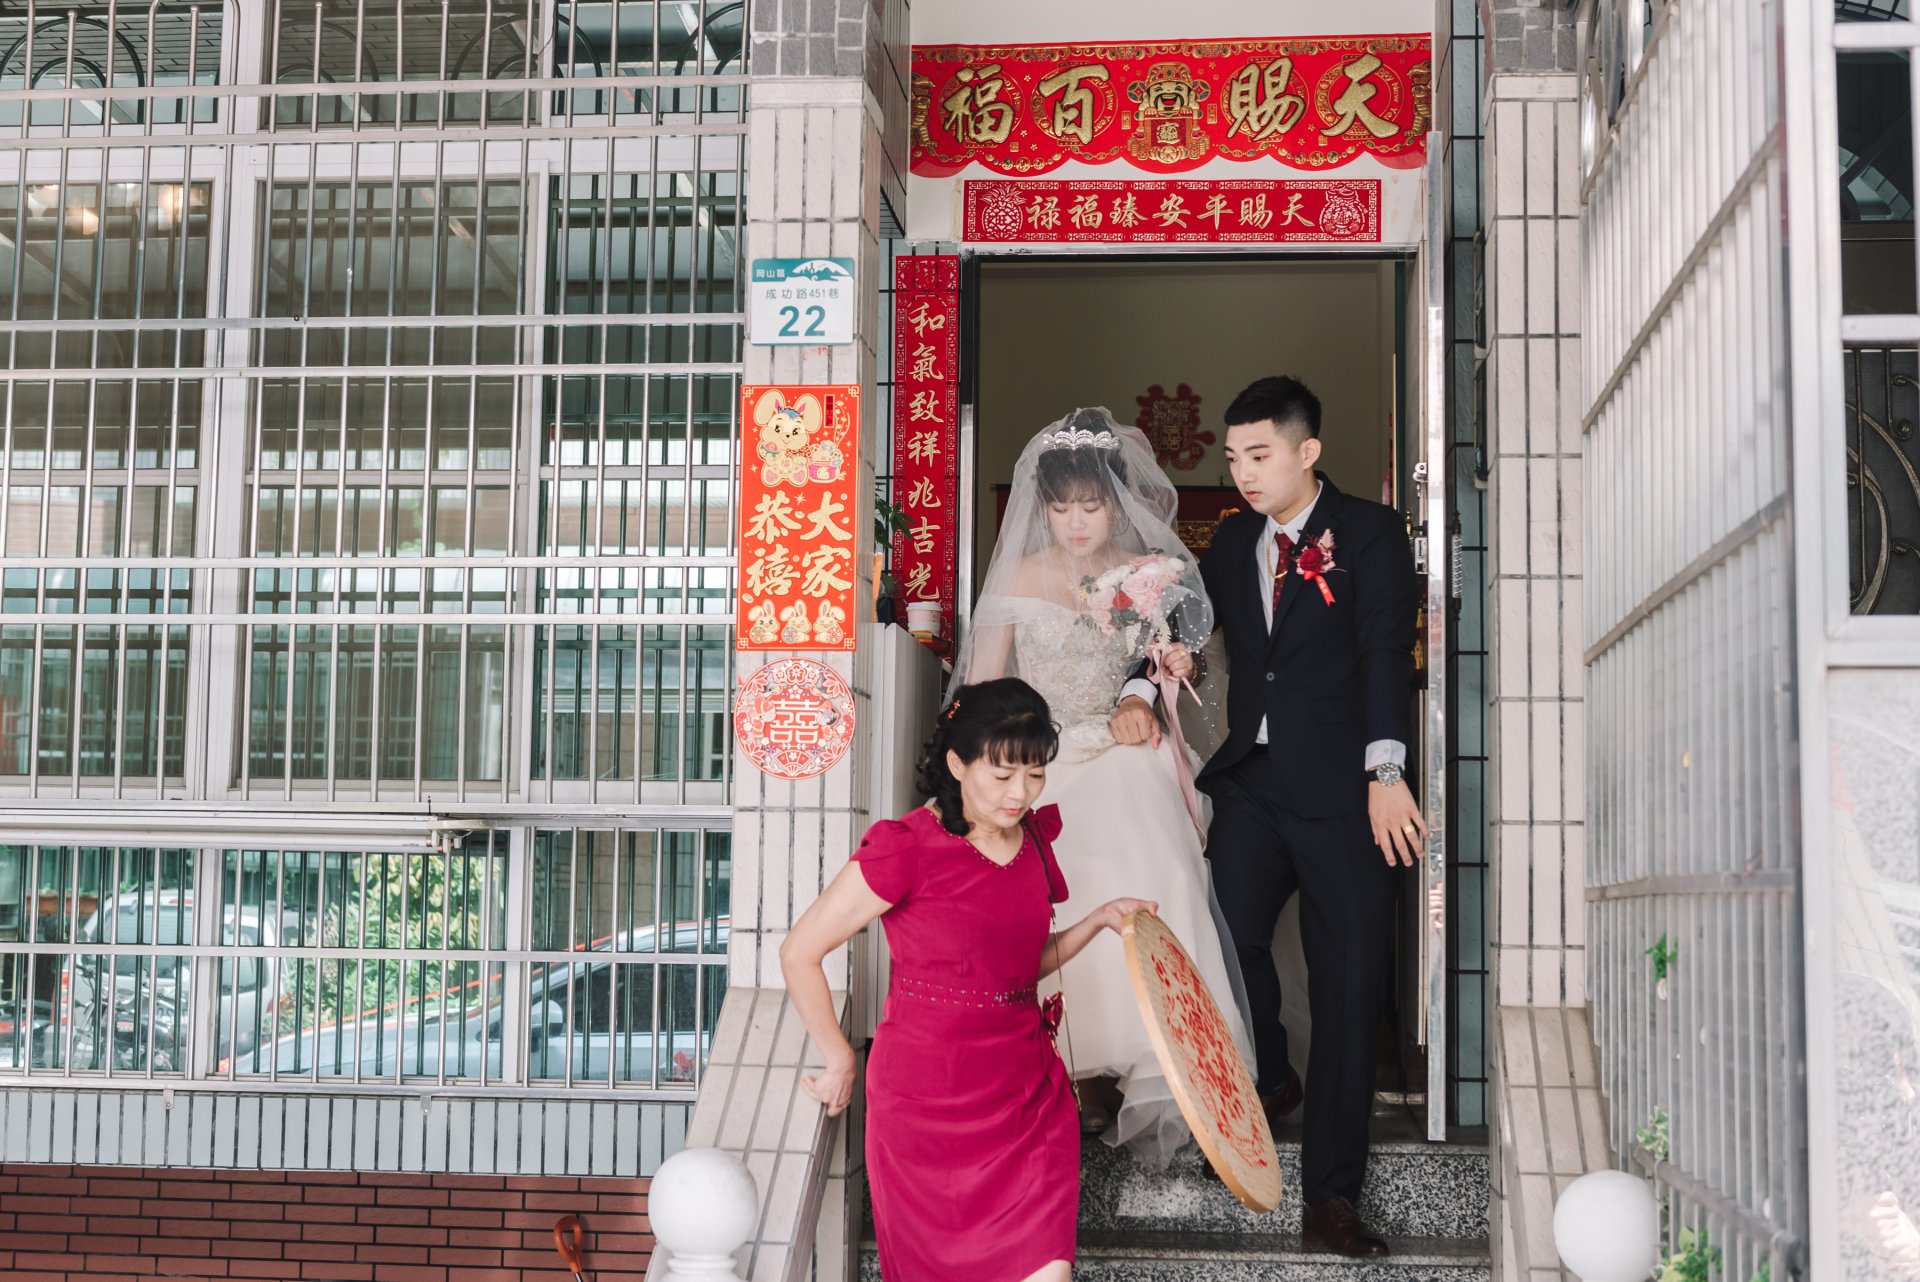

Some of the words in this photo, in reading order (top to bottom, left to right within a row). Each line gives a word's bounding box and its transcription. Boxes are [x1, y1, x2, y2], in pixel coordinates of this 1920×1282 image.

[765, 288, 839, 299] 成功路451巷
[778, 305, 826, 337] 22
[904, 302, 945, 599] 和氣致祥兆吉光
